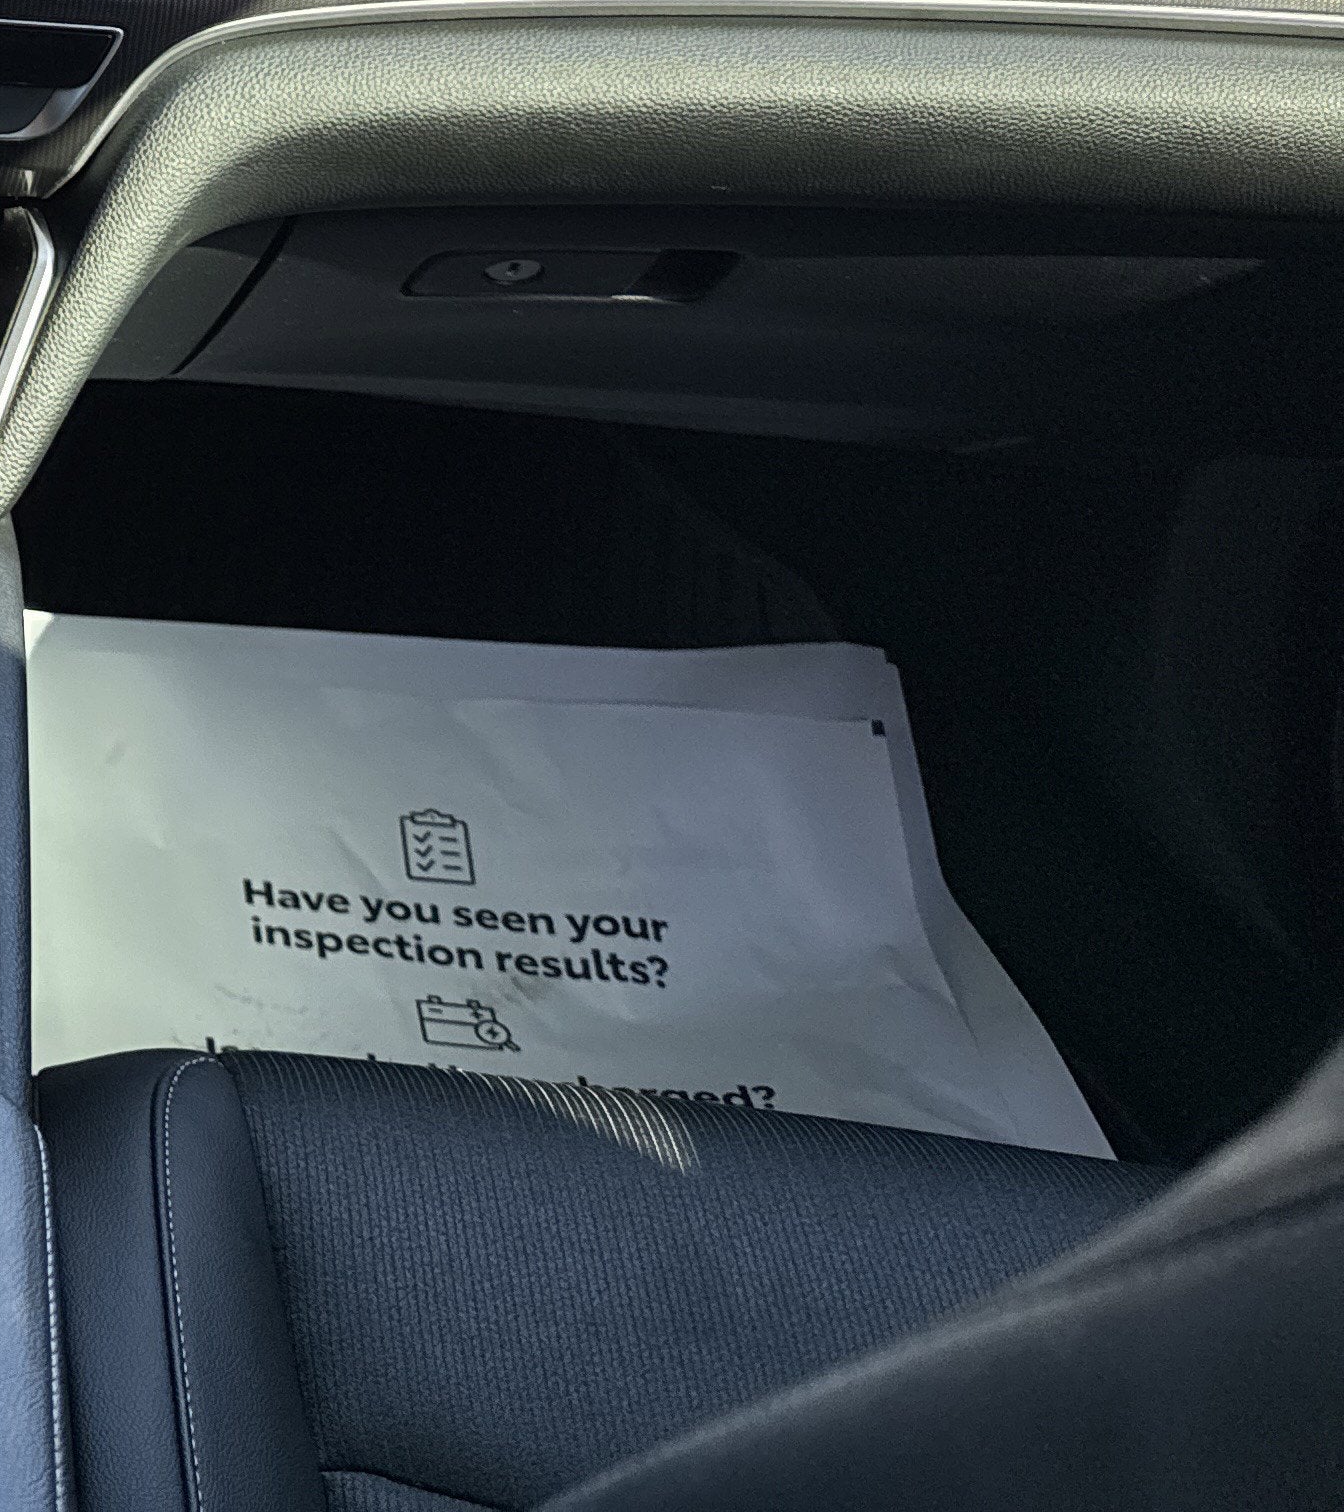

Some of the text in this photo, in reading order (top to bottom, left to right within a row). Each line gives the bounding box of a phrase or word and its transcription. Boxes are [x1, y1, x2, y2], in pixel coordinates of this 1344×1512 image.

[242, 878, 669, 943] Have you seen your
[251, 916, 670, 988] inspection results?
